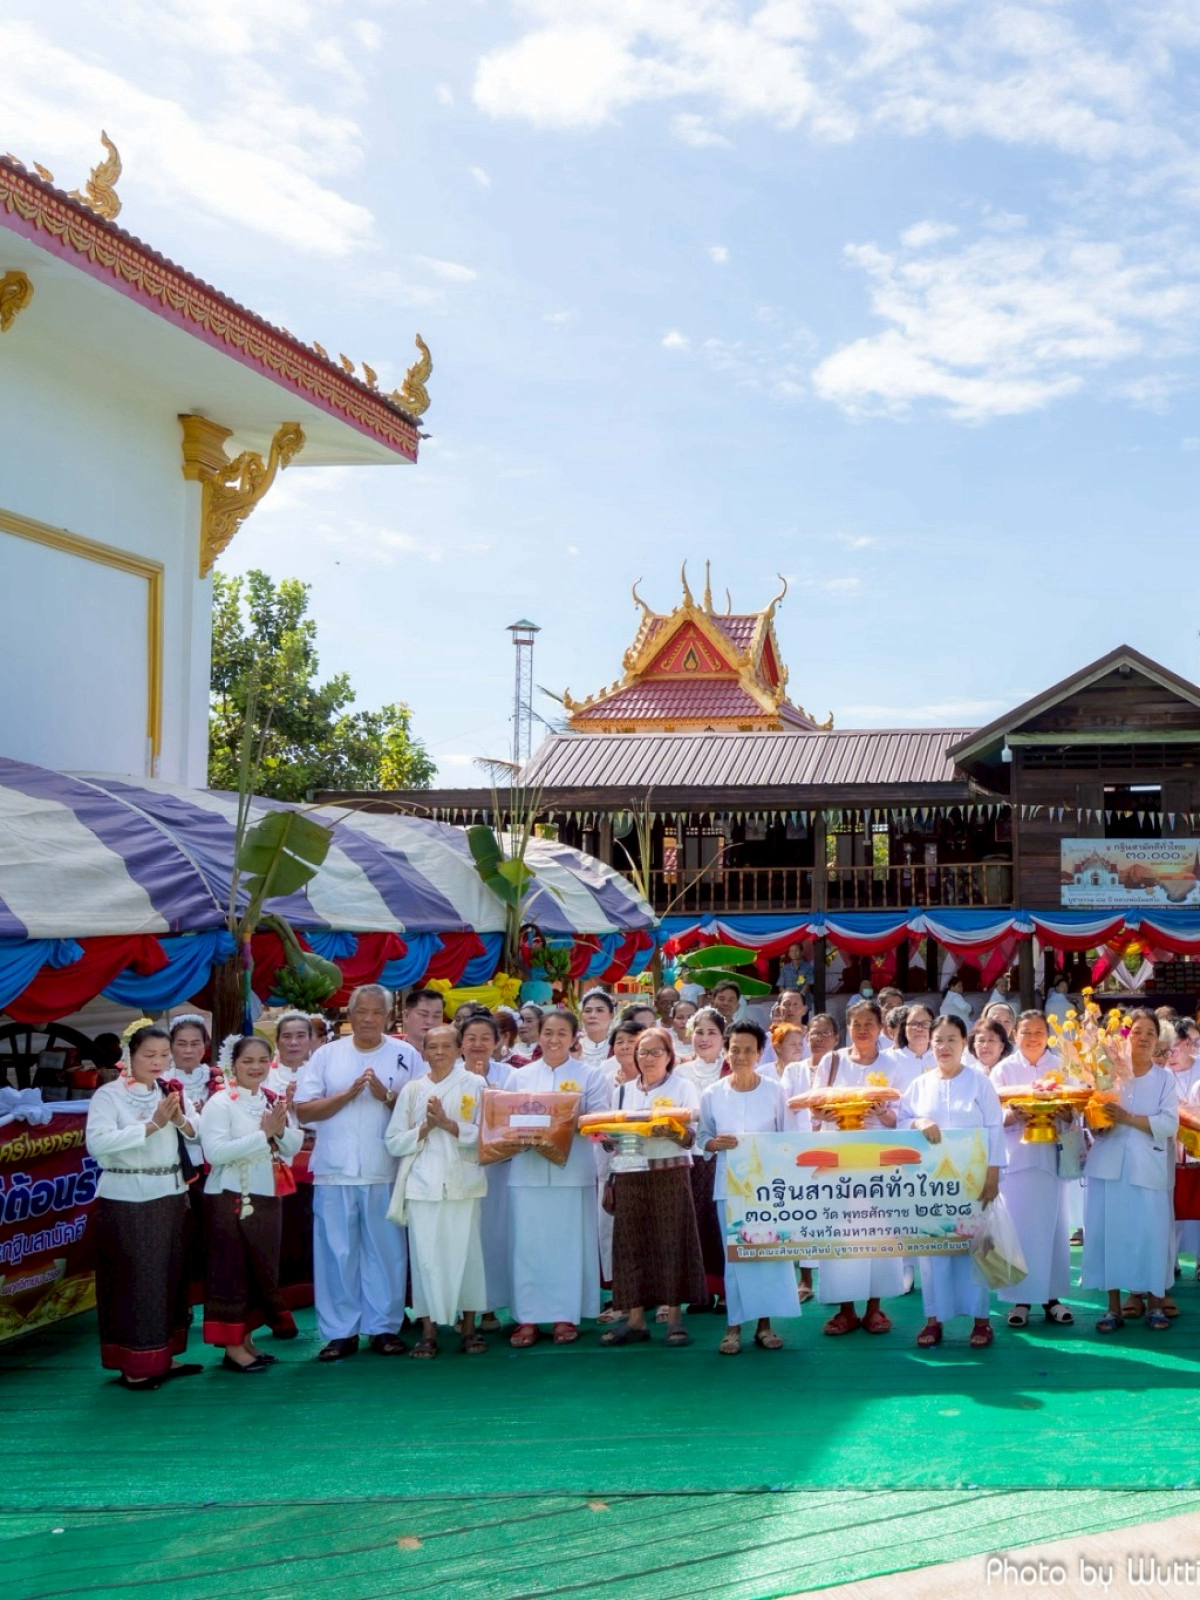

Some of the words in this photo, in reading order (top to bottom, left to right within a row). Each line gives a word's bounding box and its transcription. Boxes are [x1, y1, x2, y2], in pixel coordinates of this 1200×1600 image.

[756, 1169, 960, 1207] กฐินสามัคคีทั่วไทย
[745, 1209, 818, 1224] ๓๐,๐๐๐
[822, 1207, 838, 1220] วัด
[842, 1206, 910, 1223] พุทธศักราช
[915, 1202, 972, 1217] ๒๕๖๘
[800, 1225, 919, 1238] จังหวัดมหาสารคาม
[738, 1246, 757, 1257] โดย
